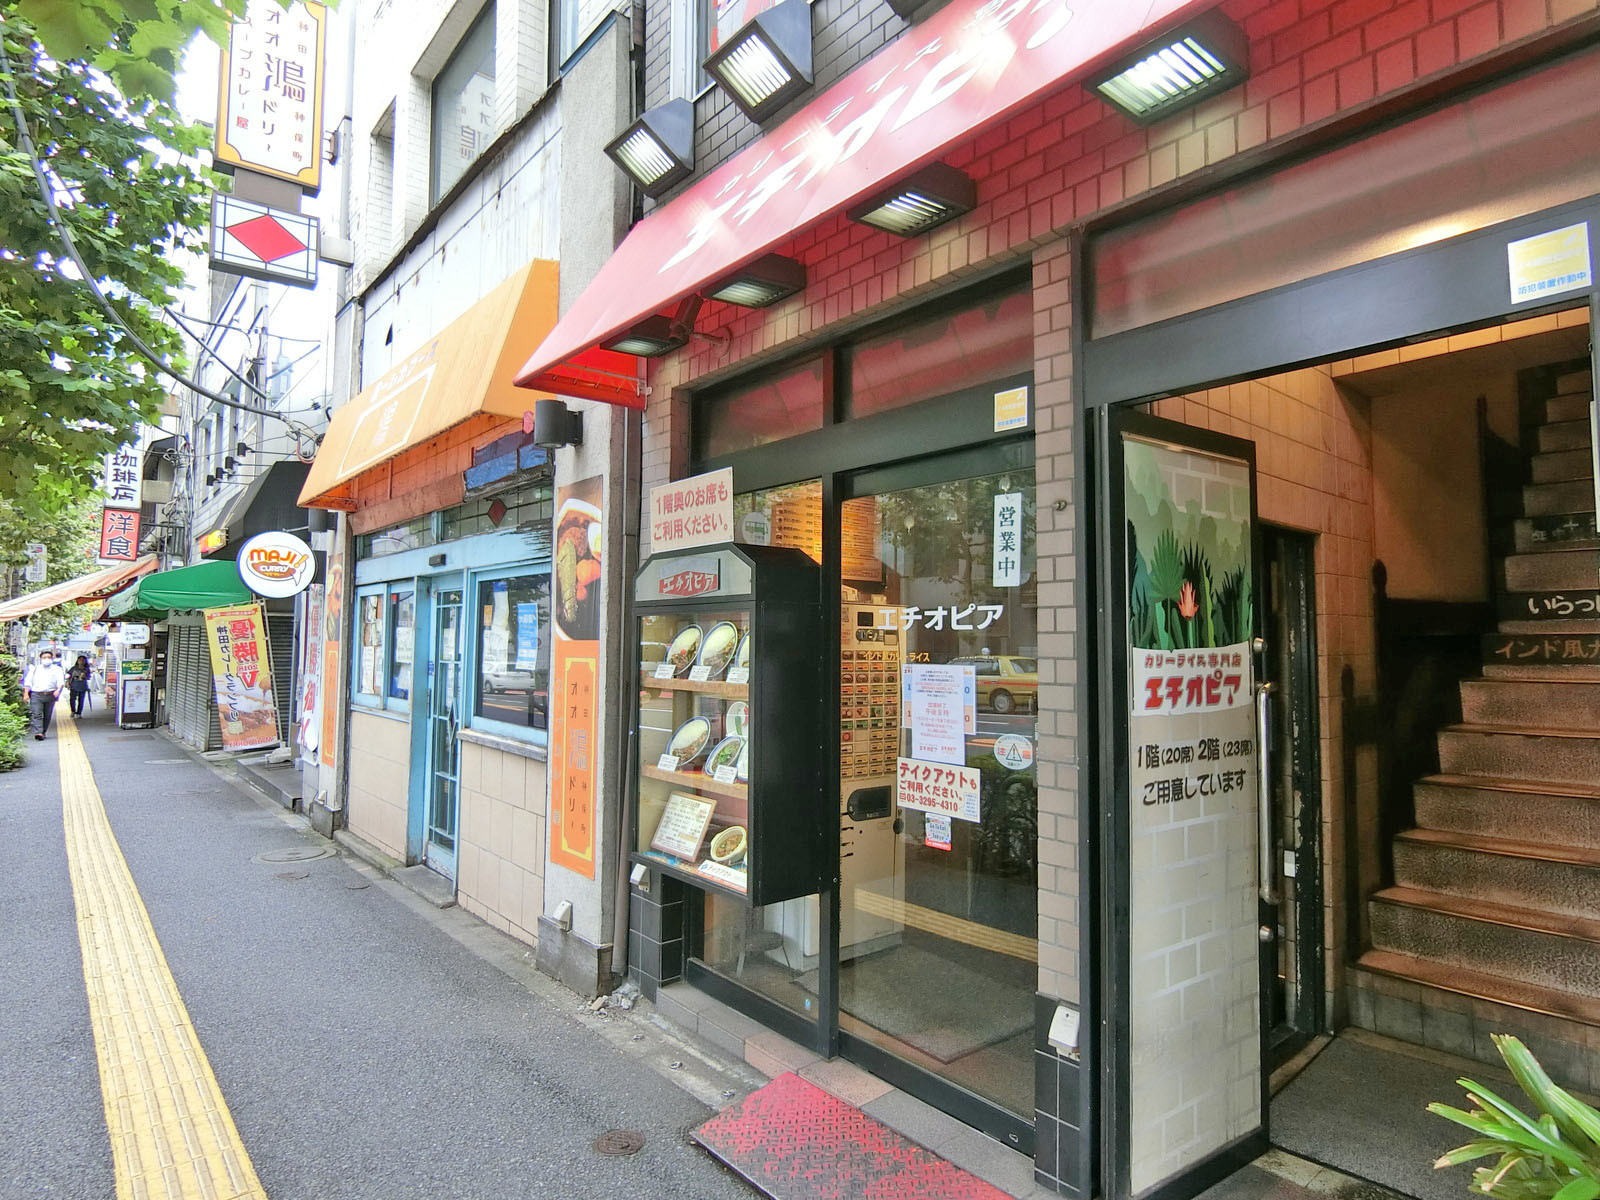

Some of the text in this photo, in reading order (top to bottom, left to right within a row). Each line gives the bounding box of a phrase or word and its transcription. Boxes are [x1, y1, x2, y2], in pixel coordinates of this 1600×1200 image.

[112, 449, 138, 501] 珈琲店
[655, 481, 728, 515] 1階奥のお席も
[106, 512, 134, 557] 洋食
[654, 513, 728, 541] ご利用ください。
[999, 506, 1016, 578] 営業中
[249, 548, 310, 569] MAJI!
[259, 565, 290, 573] CURRY
[876, 603, 1004, 631] エチオピア
[1144, 652, 1242, 668] カリーライス専門店
[1144, 668, 1242, 711] エチオピア
[899, 762, 977, 790] テイクアウトも
[1142, 768, 1246, 806] ご用意しています
[899, 780, 963, 801] ご利用ください。
